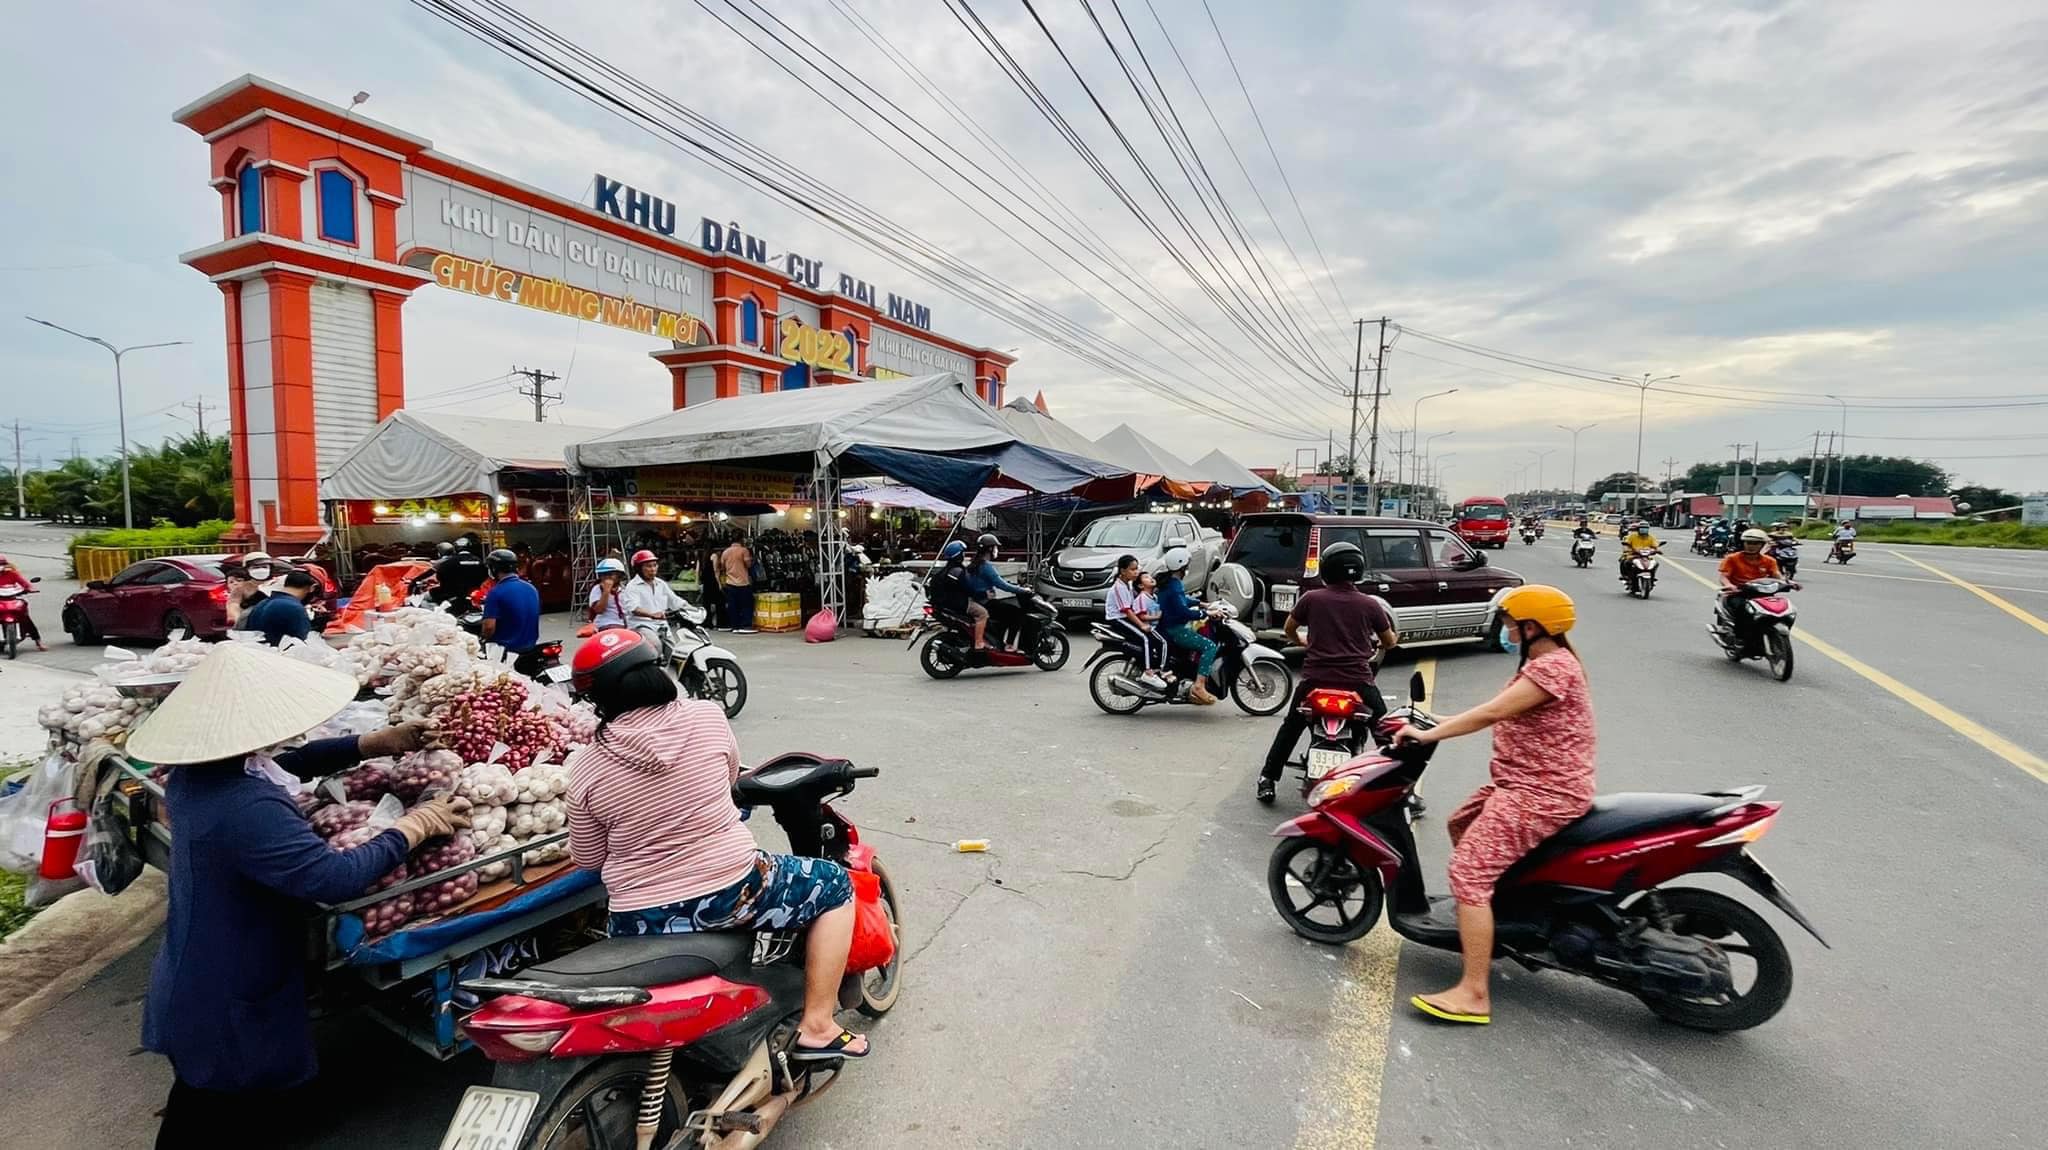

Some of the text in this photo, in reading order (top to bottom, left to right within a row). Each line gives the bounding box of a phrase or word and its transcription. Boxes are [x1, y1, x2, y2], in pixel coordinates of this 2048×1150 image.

[441, 199, 692, 296] KHU DÂN CƯ ĐẠI NAM
[594, 174, 676, 236] KHU
[701, 216, 767, 264] DÂN
[787, 252, 823, 289] CƯ
[888, 292, 931, 331] NAM
[431, 254, 700, 346] CHÚC MỪNG NĂM MỚI
[780, 318, 851, 373] 2022
[462, 1092, 523, 1133] 72-T1
